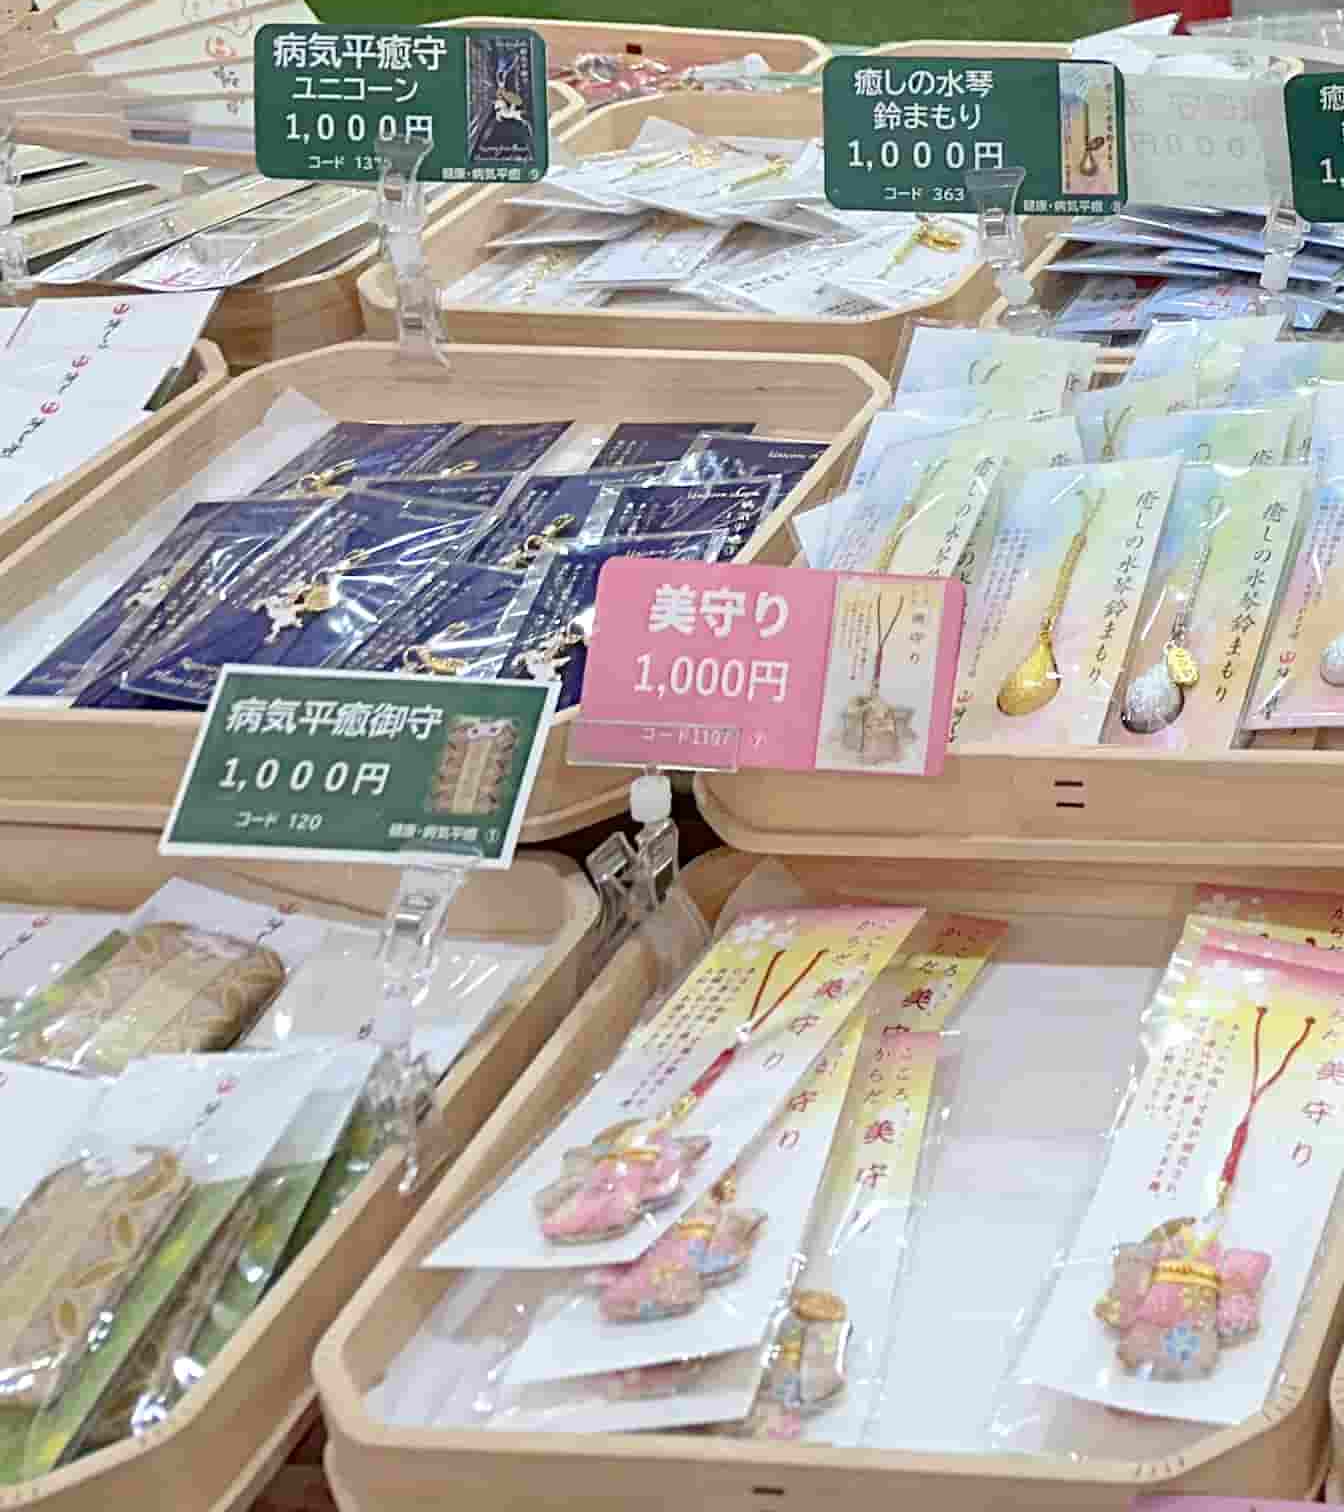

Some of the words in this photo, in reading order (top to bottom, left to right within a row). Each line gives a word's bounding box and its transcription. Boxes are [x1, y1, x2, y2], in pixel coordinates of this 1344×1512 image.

[273, 32, 448, 71] 病気平癒守
[292, 76, 419, 104] ユニコーン
[853, 68, 995, 98] 癒しの水琴
[285, 113, 433, 145] 1,000円
[873, 102, 982, 131] 鈴まもり
[308, 156, 345, 169] コード
[848, 141, 1004, 172] 1,000円
[884, 188, 922, 201] コード
[933, 188, 965, 201] 363
[647, 583, 789, 640] 美守り
[633, 652, 789, 704] 1,000円
[225, 696, 443, 741] 病気平癒御守
[218, 757, 391, 797] 1,000円
[234, 811, 278, 829] コード
[287, 811, 323, 831] 120
